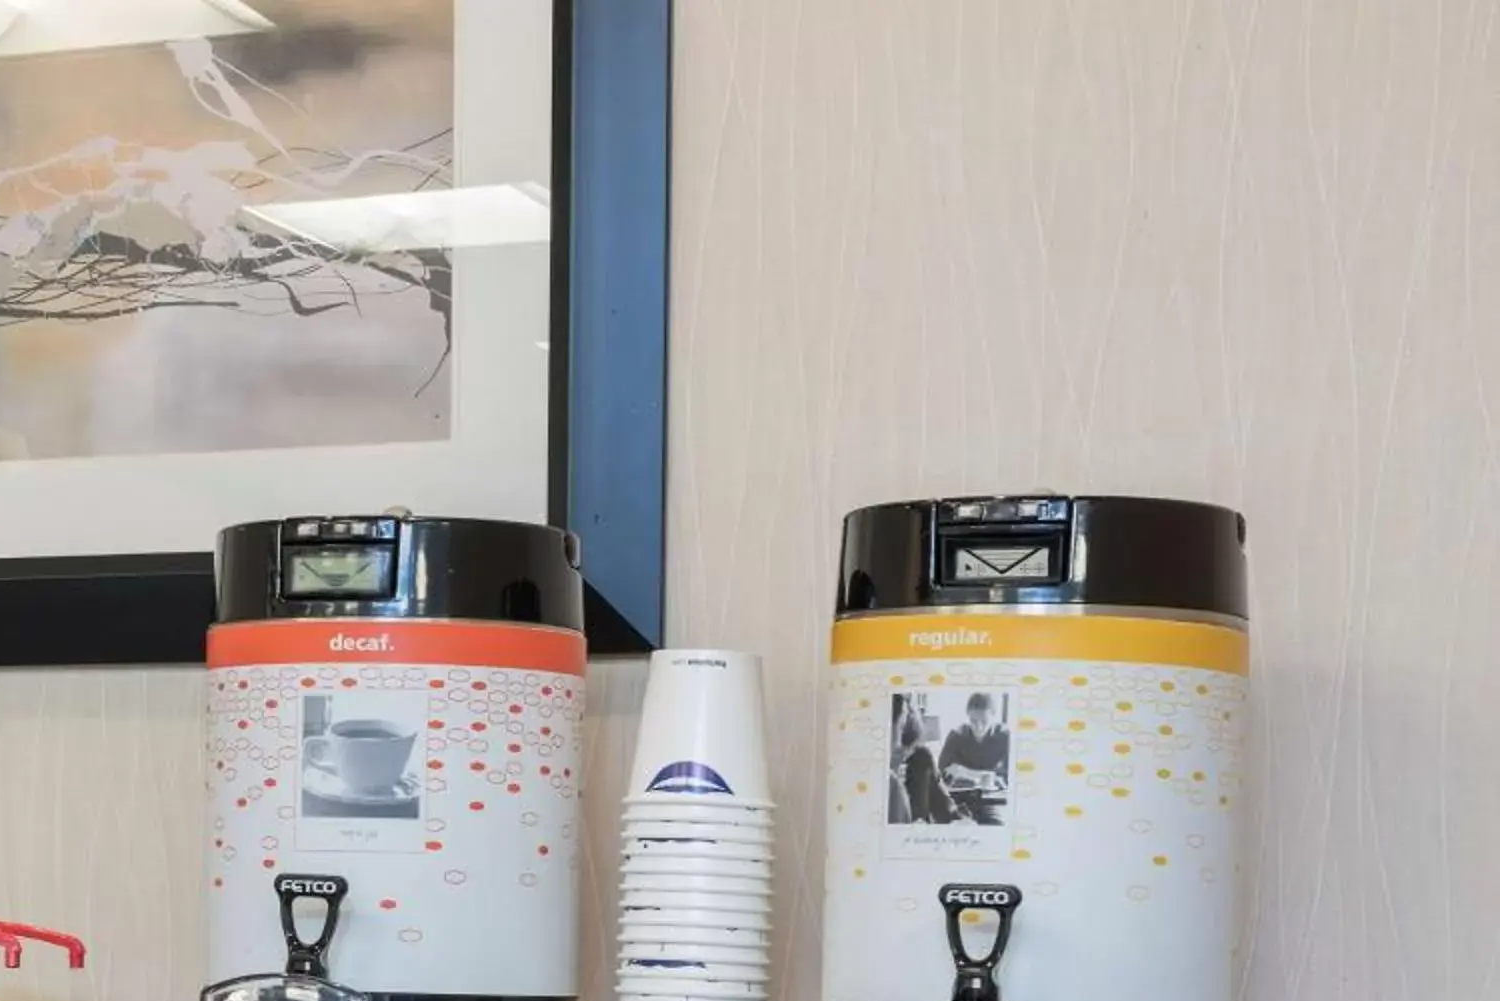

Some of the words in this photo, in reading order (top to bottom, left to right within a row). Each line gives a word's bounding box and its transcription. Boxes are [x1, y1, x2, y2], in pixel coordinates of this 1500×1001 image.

[329, 633, 395, 651] decaf.
[909, 629, 992, 650] regular.
[280, 879, 337, 894] FETCO
[945, 890, 1010, 905] FETCO
